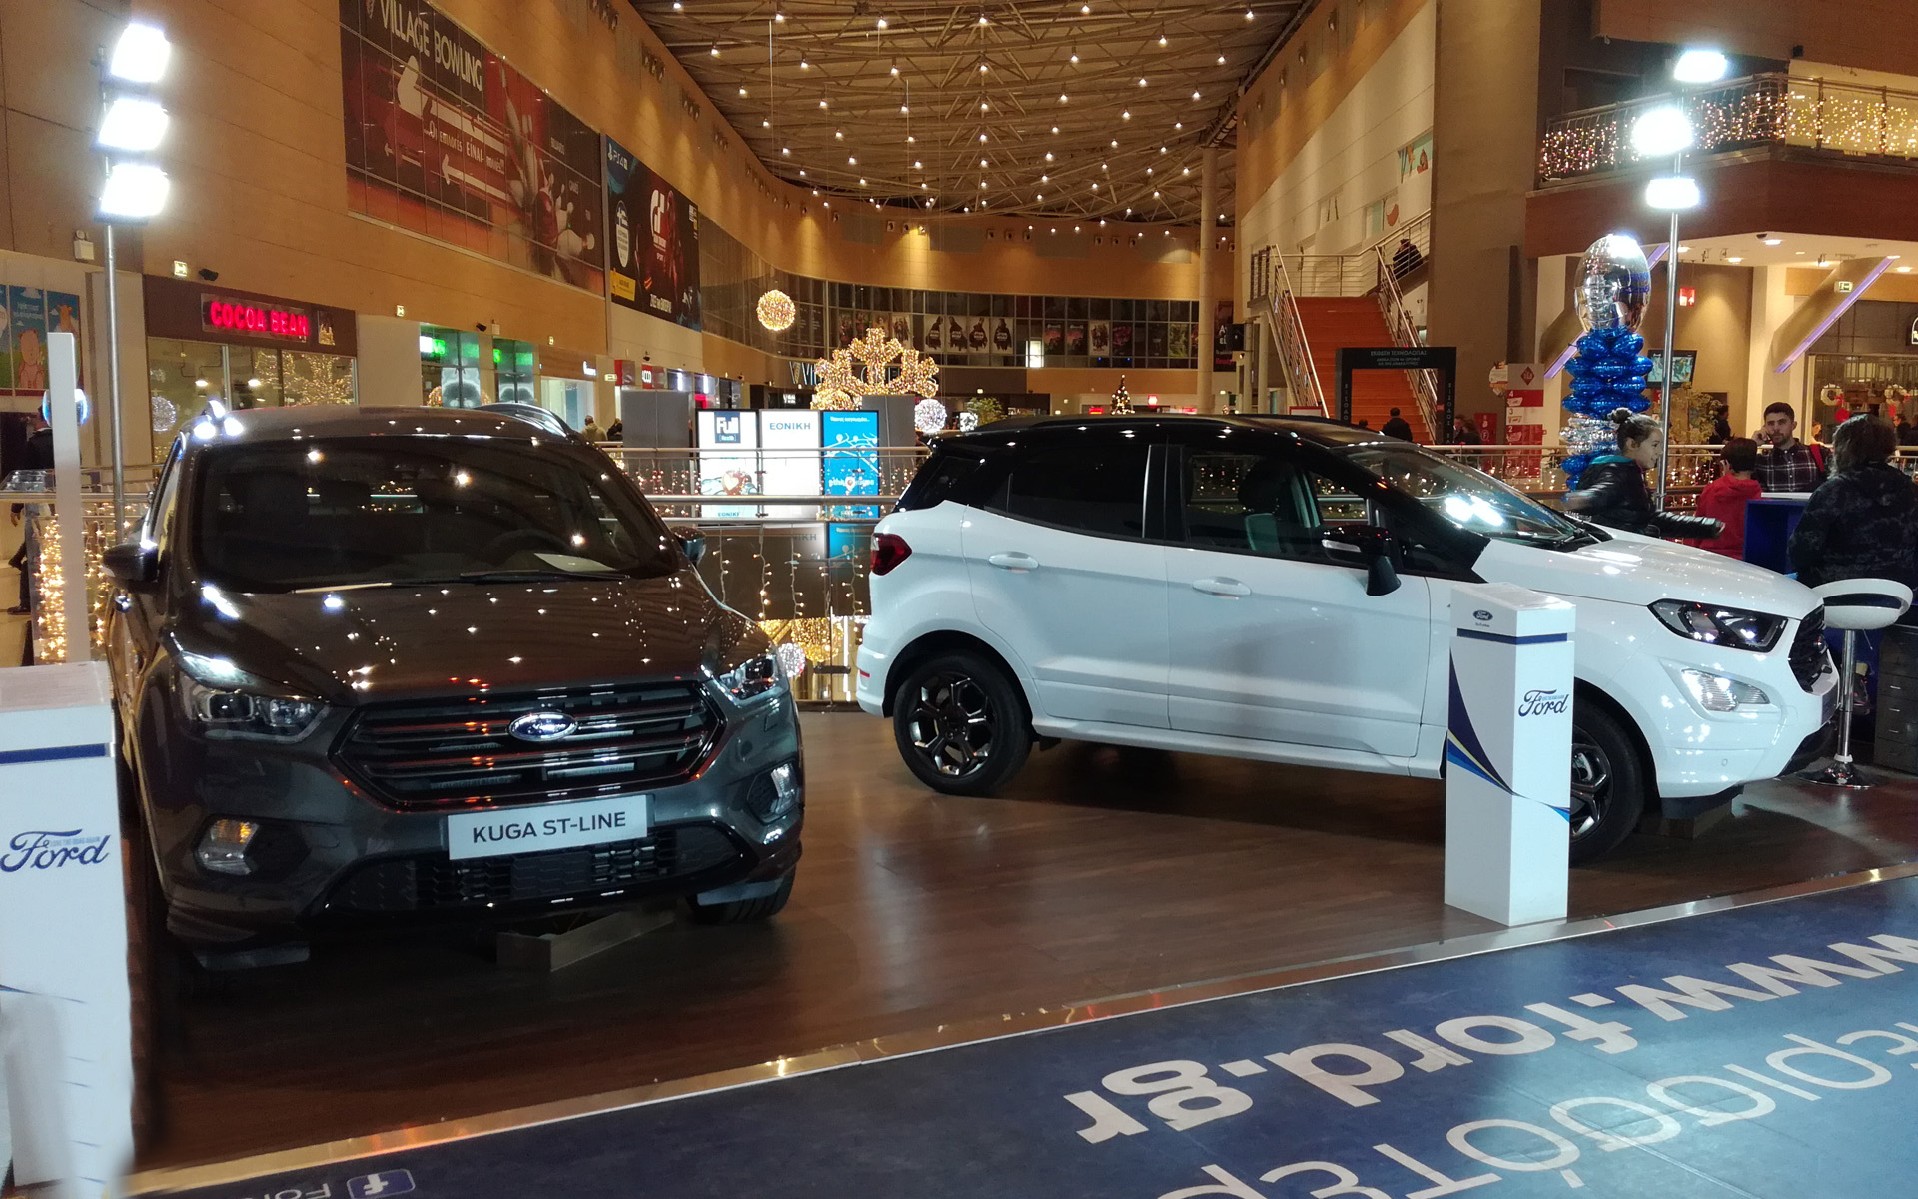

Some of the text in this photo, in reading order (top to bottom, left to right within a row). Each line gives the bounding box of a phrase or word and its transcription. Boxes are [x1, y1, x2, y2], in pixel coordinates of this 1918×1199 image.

[381, 0, 483, 92] VILLAGE BOWLING
[210, 301, 310, 337] COCOA BEAN
[1518, 689, 1569, 717] Ford
[473, 811, 626, 844] KUGA ST-LINE
[0, 828, 111, 873] Ford
[1156, 1022, 1918, 1199] ερισσότερ
